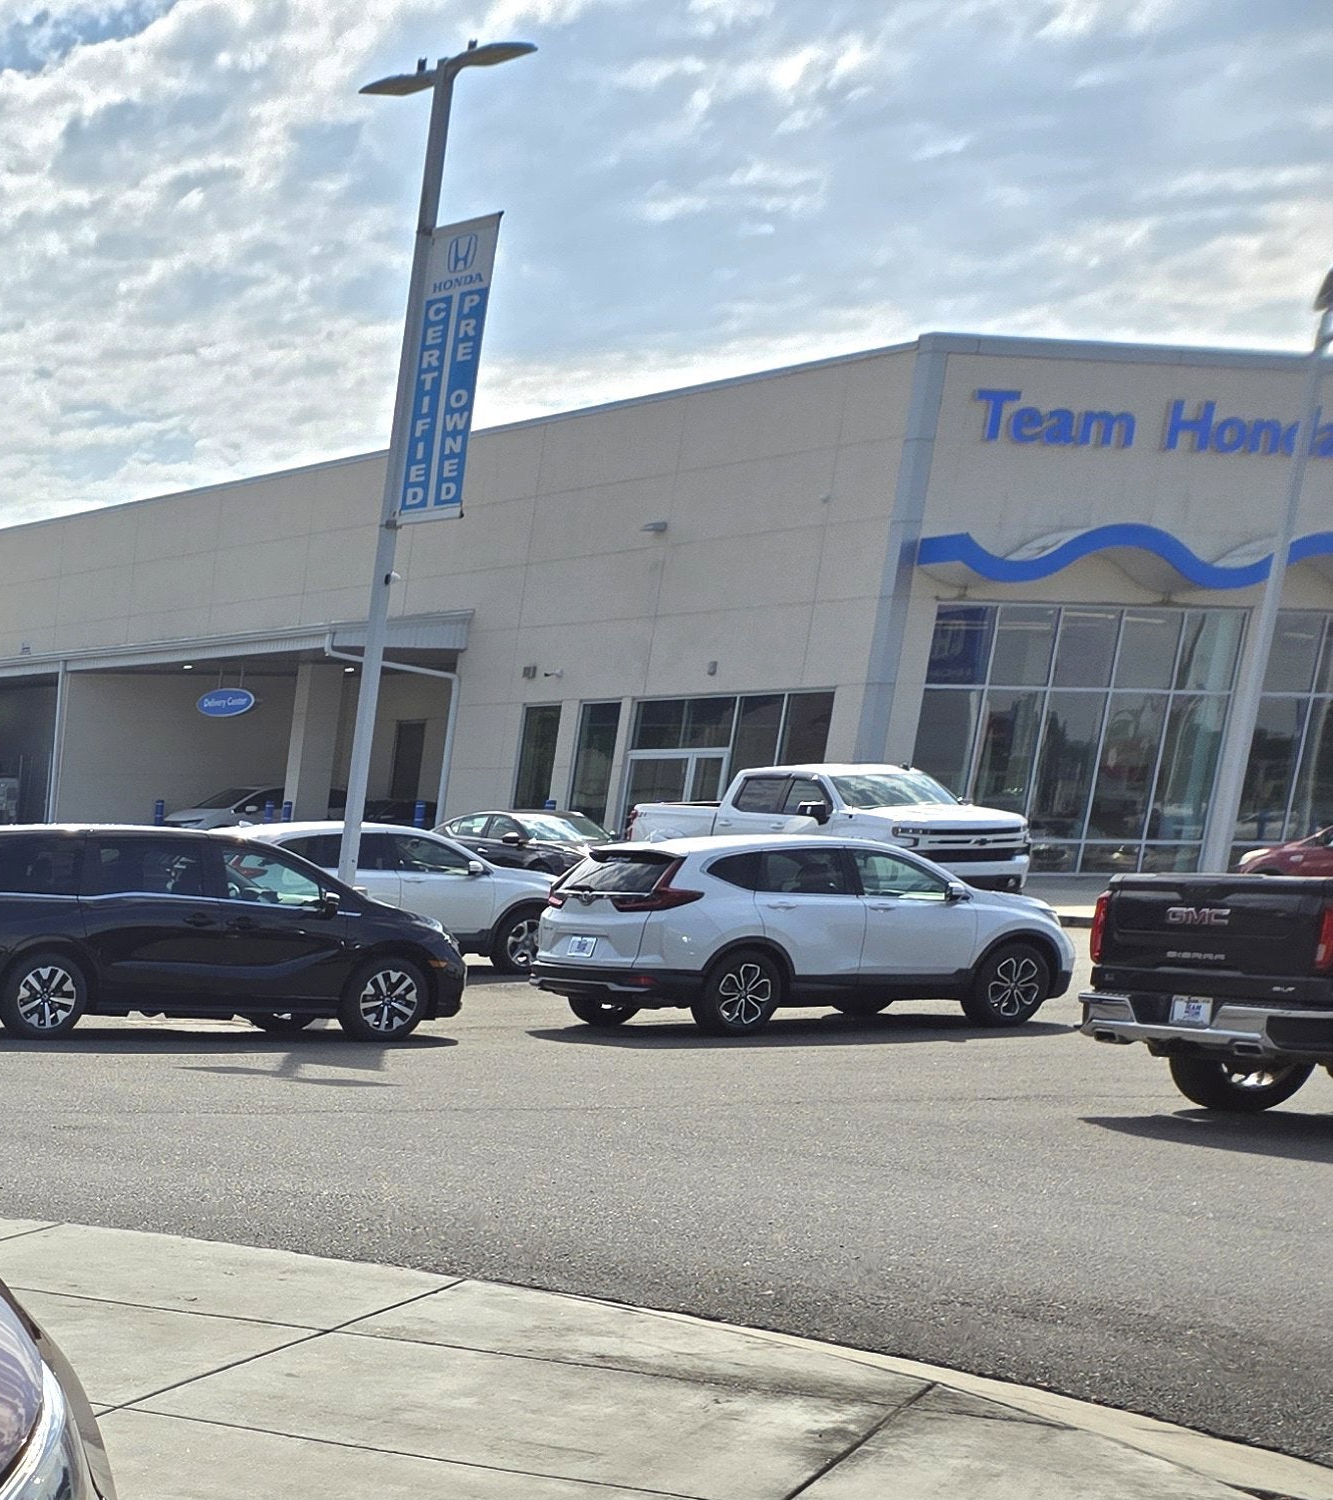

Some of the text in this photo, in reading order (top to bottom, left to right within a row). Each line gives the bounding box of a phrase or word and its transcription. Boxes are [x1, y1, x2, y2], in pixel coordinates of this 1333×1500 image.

[433, 272, 483, 293] HONDA
[405, 302, 446, 506] CERTIFIED
[440, 294, 480, 500] PRE OWNED
[975, 389, 1136, 448] Team
[1166, 906, 1231, 925] GMC
